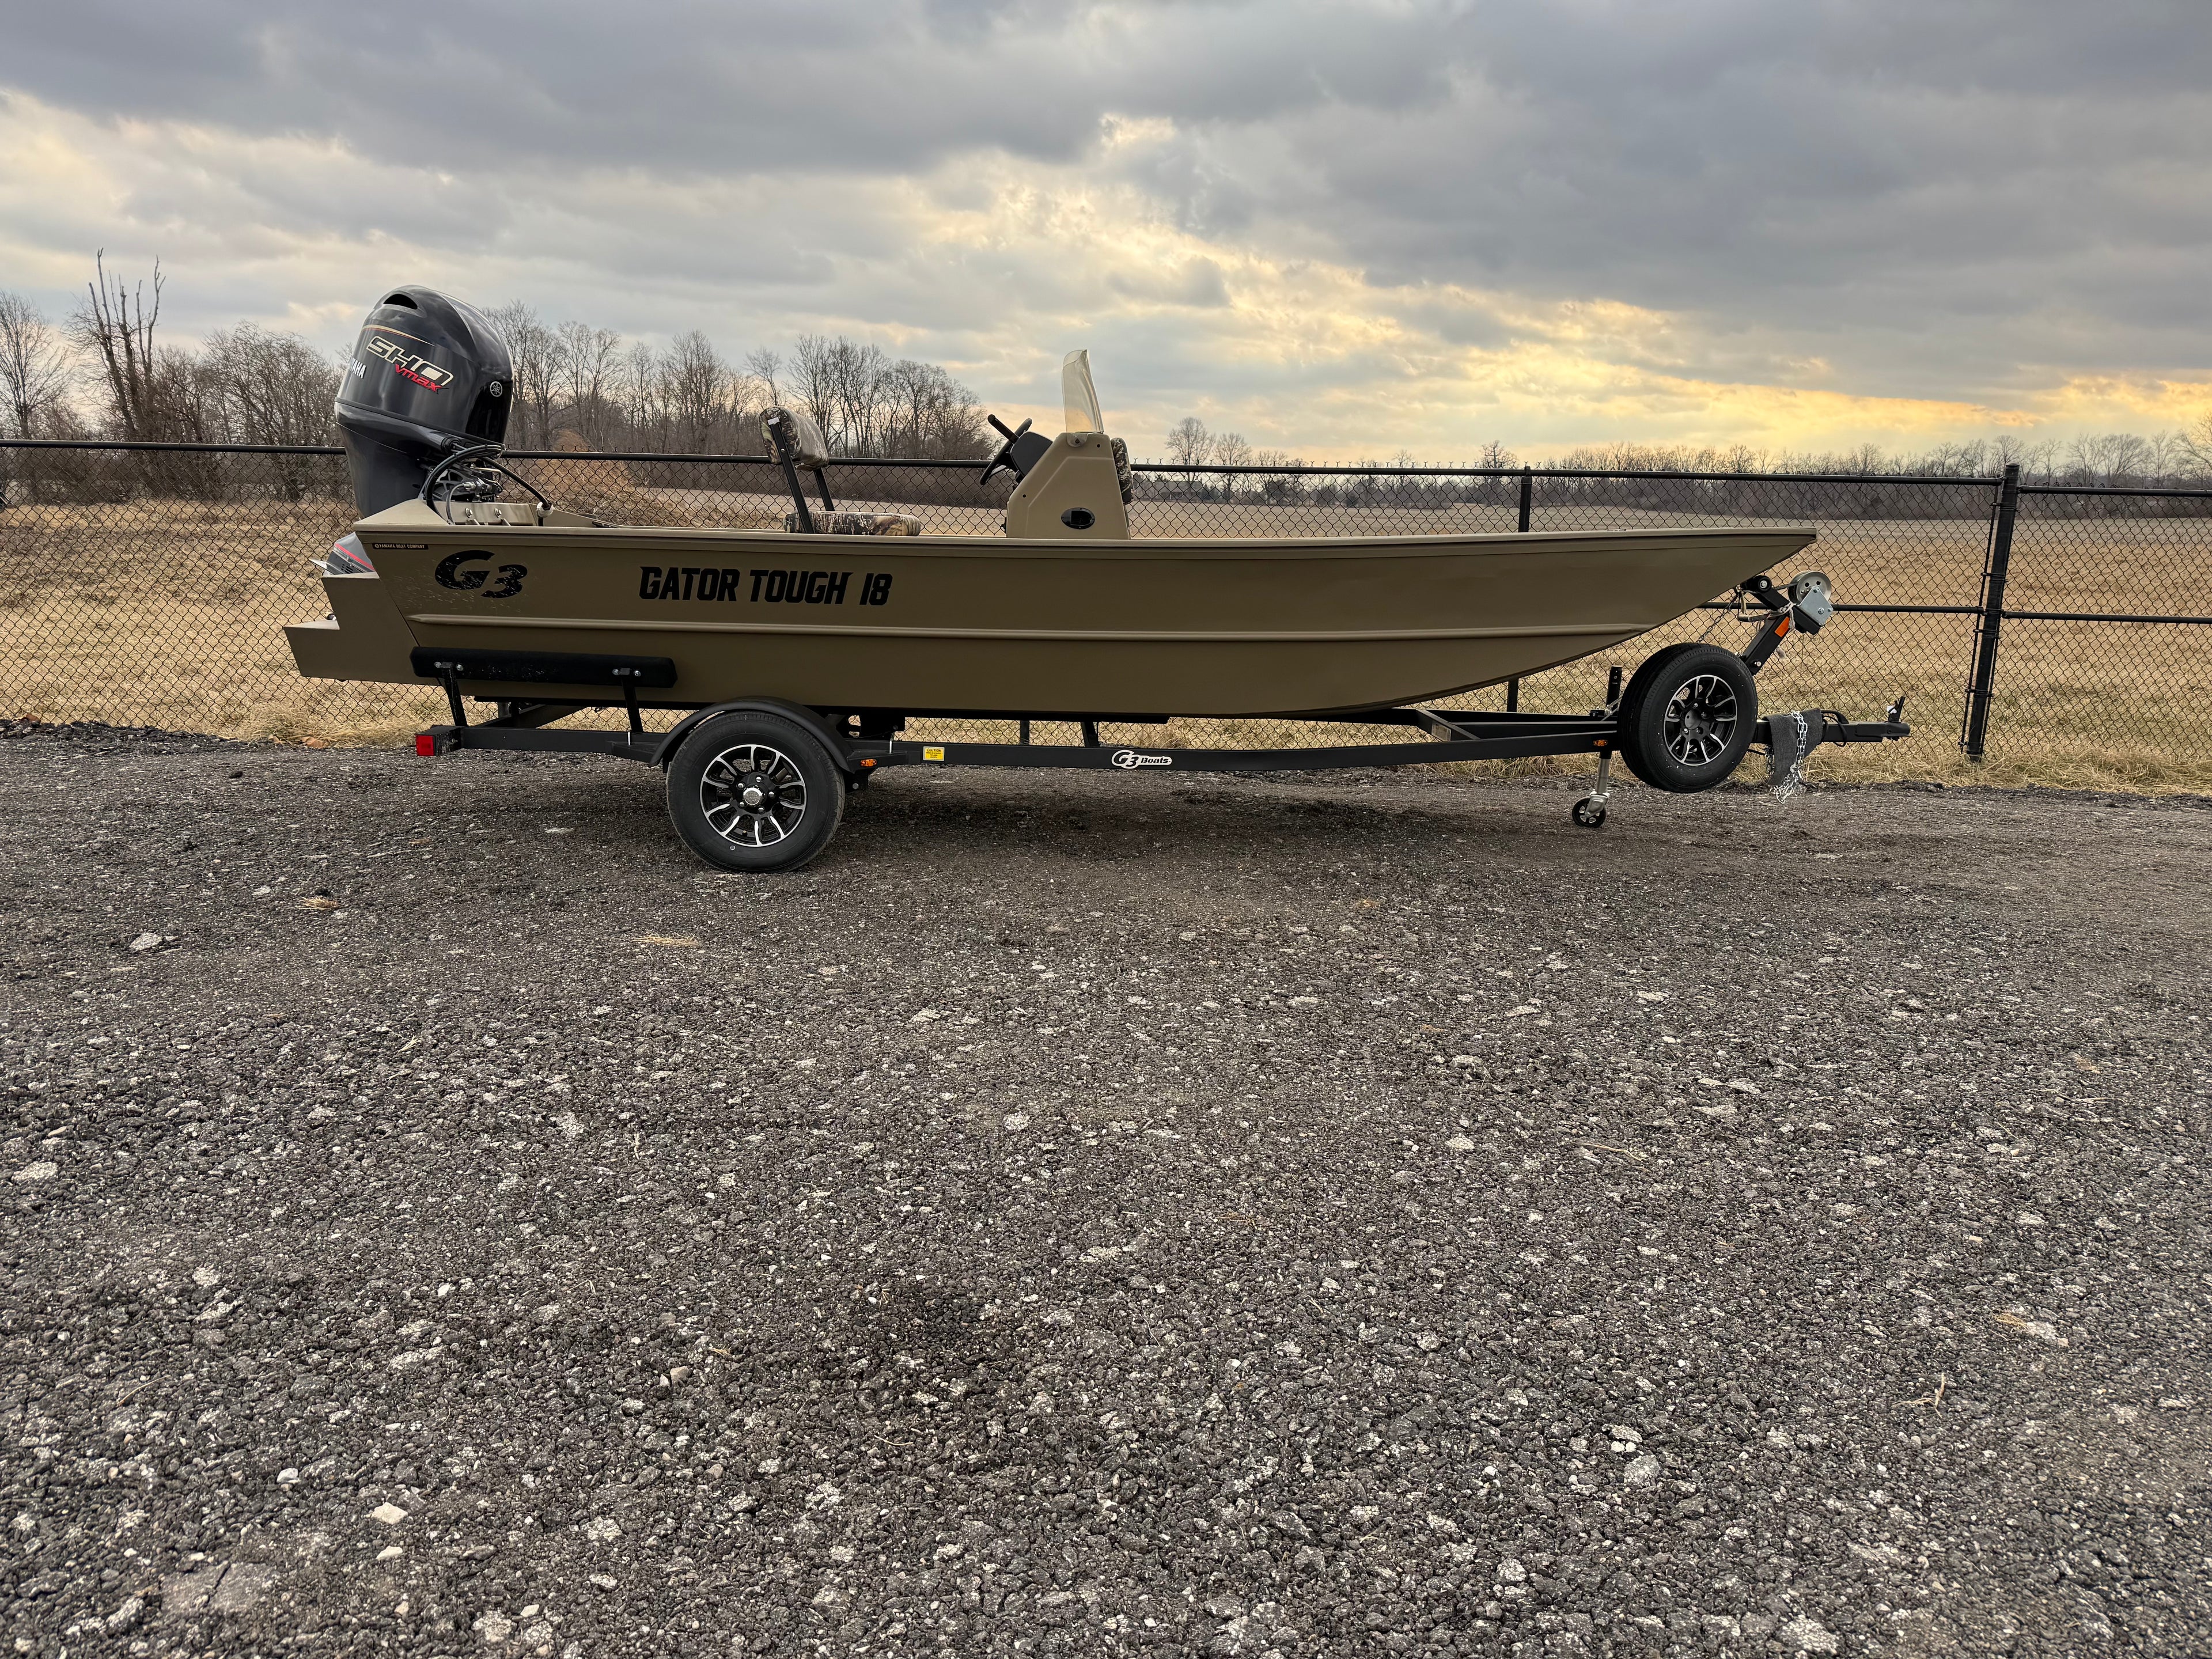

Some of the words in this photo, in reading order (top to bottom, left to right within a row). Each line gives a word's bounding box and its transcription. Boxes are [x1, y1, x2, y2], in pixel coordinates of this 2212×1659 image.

[366, 336, 454, 387] SHO
[435, 550, 528, 598] G3
[639, 566, 740, 601] GATOR
[749, 569, 854, 604] TOUGH
[859, 573, 893, 605] 18
[1113, 751, 1139, 767] G3
